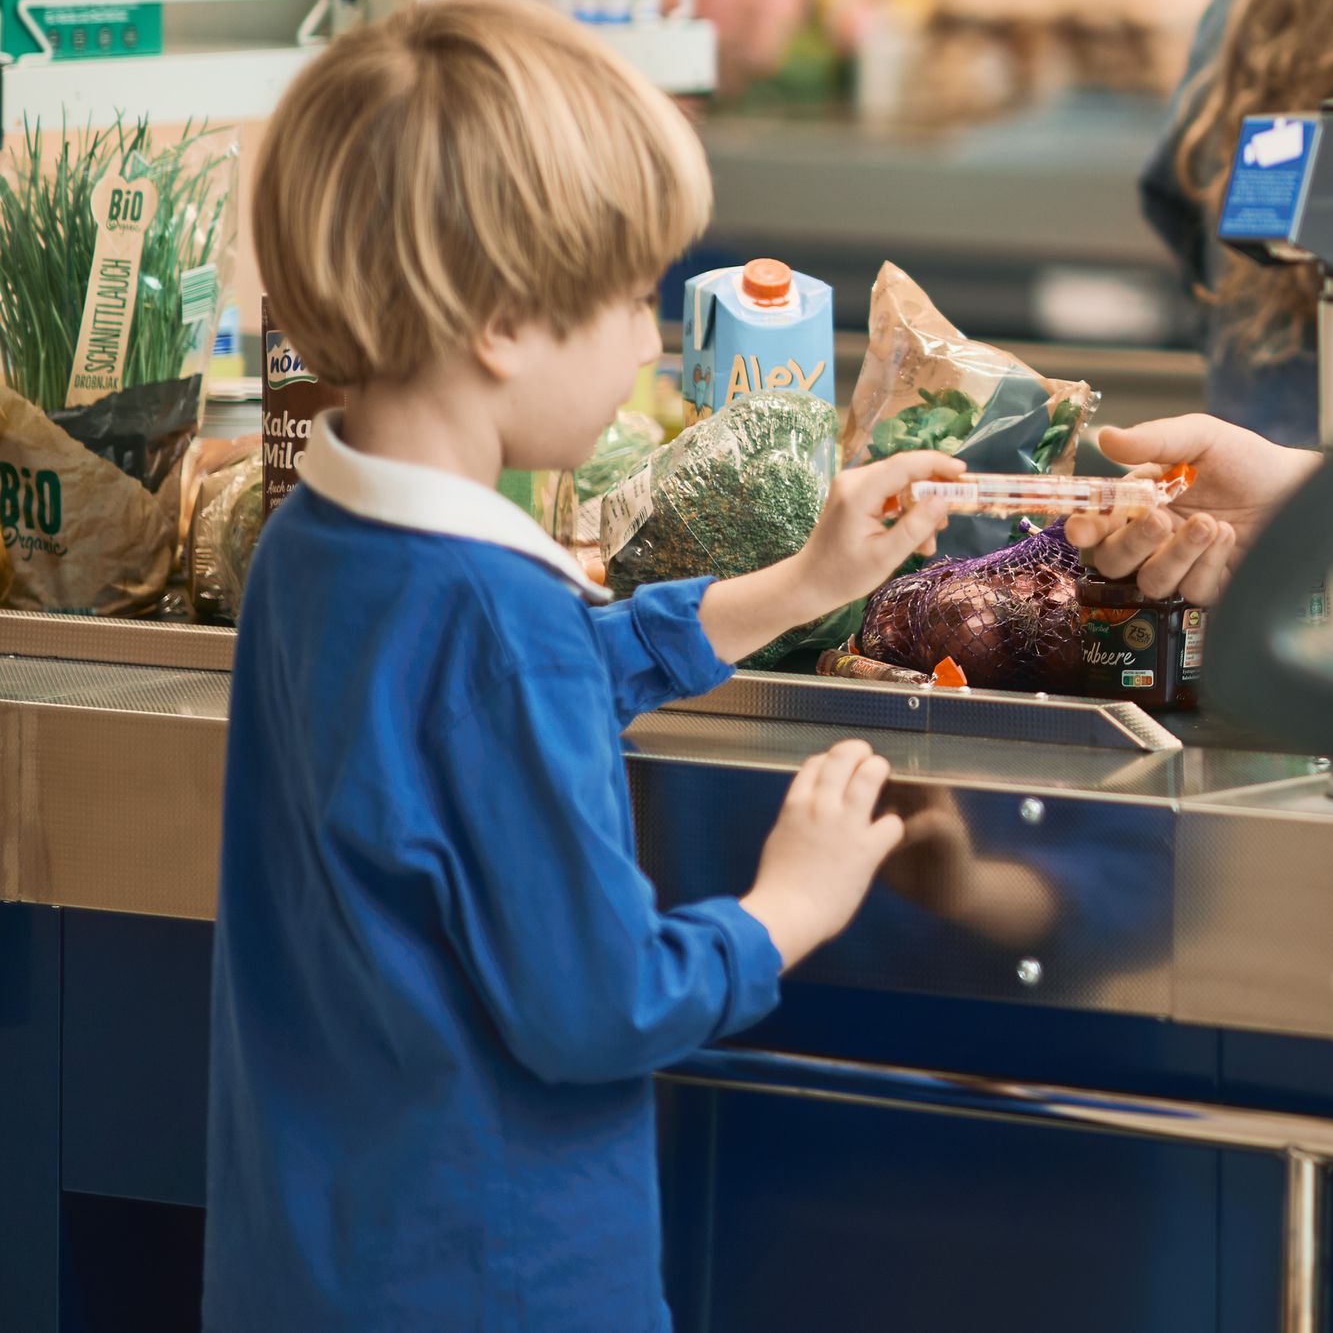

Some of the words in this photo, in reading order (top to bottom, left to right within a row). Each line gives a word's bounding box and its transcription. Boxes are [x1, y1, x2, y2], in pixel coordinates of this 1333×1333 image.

[84, 257, 132, 374] SCHNITTLAUCH
[262, 409, 312, 439] Kaka
[263, 441, 306, 470] Milc
[1080, 640, 1137, 666] rdbeere
